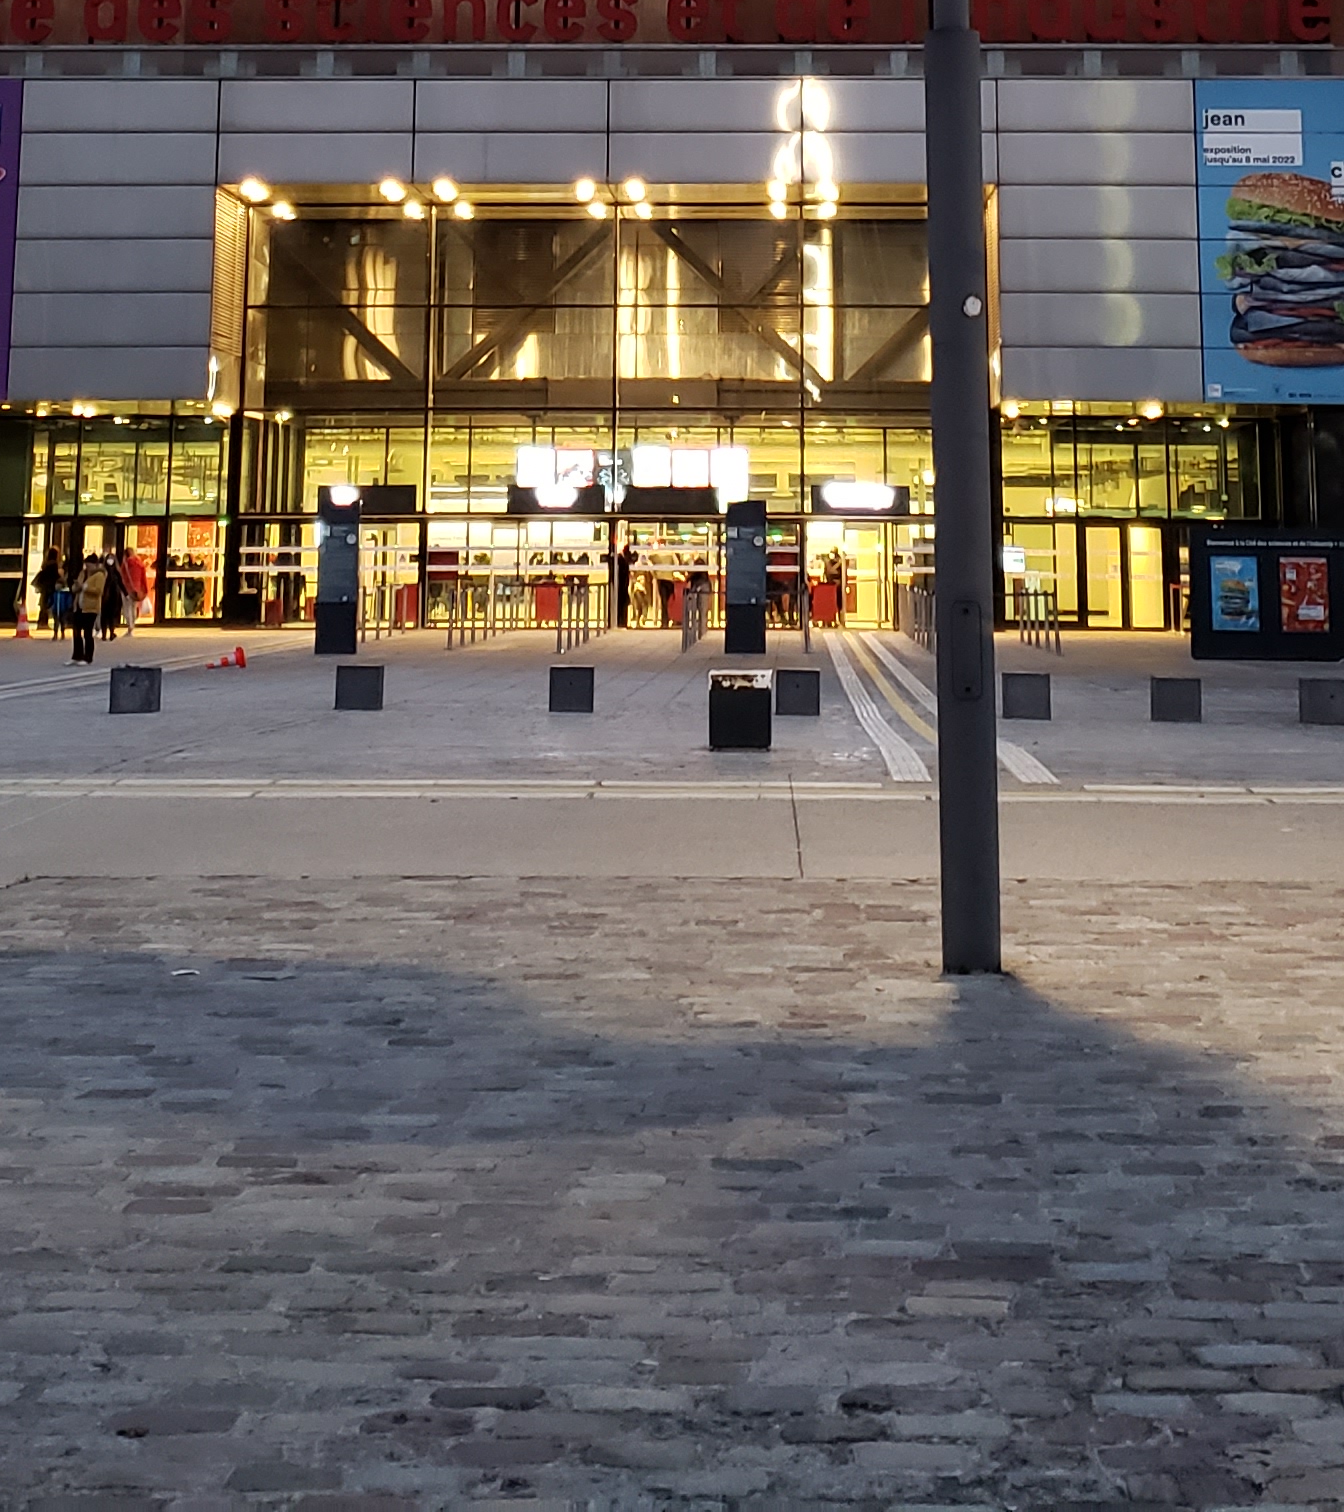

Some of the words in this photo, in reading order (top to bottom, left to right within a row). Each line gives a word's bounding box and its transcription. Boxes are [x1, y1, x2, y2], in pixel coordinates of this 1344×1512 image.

[1203, 109, 1246, 130] jean
[1203, 144, 1252, 155] exposition
[1204, 154, 1243, 165] jusqu'au
[1245, 155, 1251, 164] 8
[1253, 154, 1270, 164] mai
[1271, 155, 1296, 164] 2022
